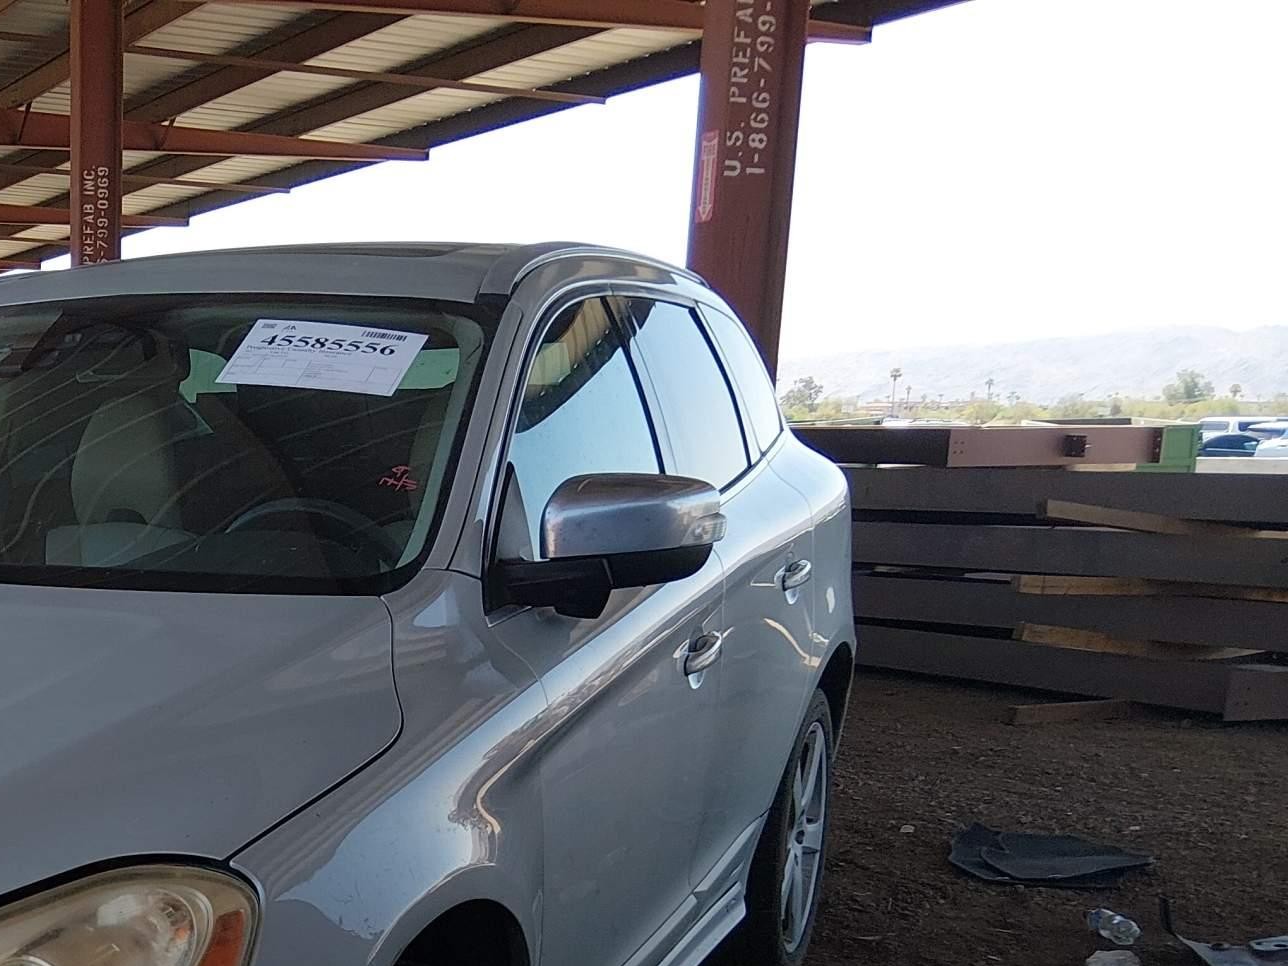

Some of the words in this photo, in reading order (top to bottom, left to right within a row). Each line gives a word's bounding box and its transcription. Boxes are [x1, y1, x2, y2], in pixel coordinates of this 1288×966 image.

[723, 122, 745, 177] U.S.
[83, 164, 96, 195] INC.
[83, 204, 95, 265] PREFAB
[260, 333, 400, 357] 45585556
